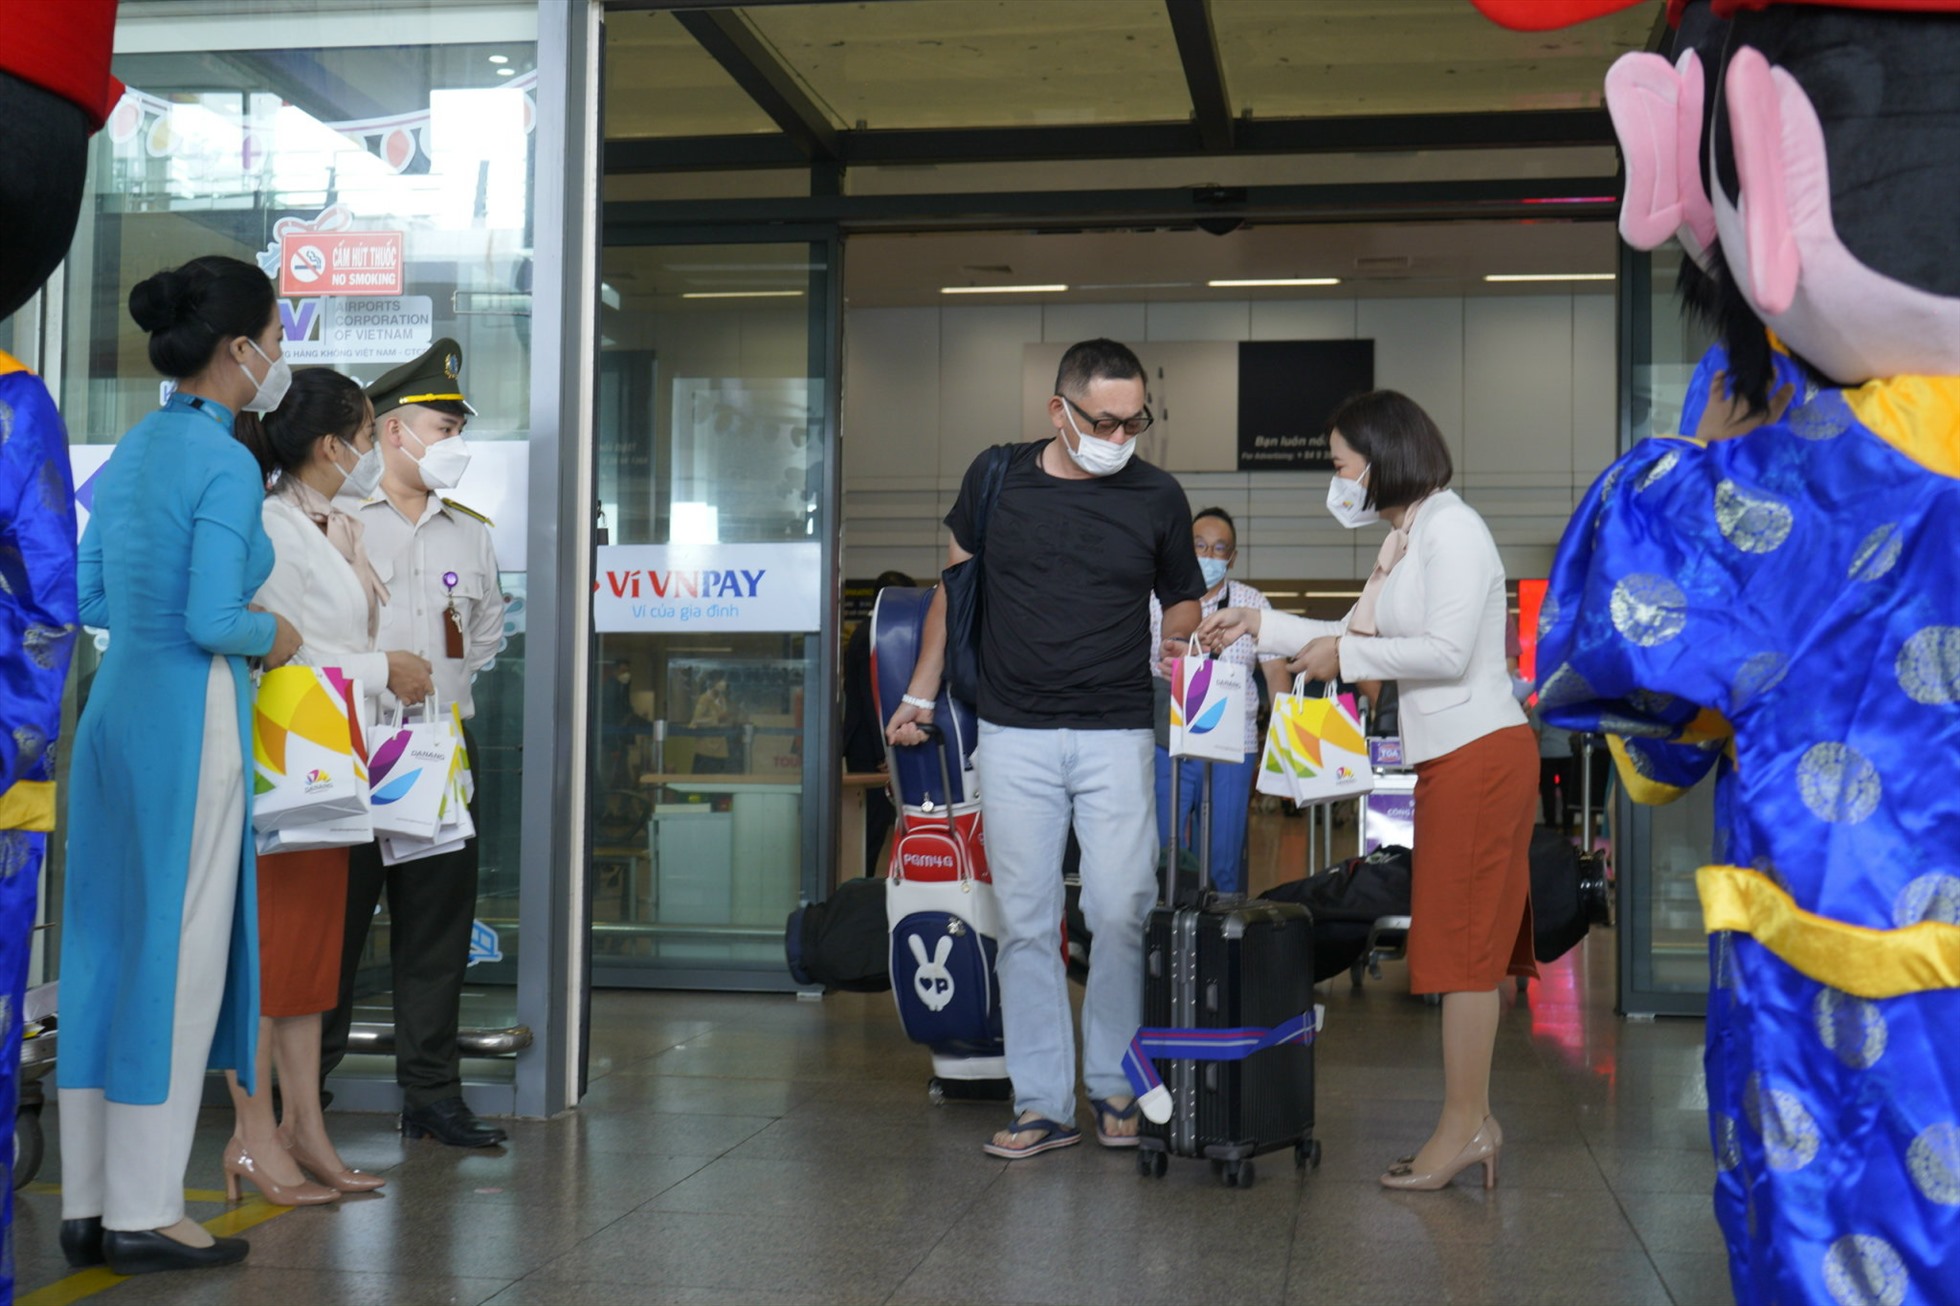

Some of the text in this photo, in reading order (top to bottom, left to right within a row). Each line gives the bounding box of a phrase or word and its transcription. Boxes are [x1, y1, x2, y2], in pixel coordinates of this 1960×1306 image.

[332, 238, 397, 267] CẤM HÚT THUỐC
[331, 272, 397, 286] NO SMOKING
[335, 300, 402, 313] AIRPORTS
[334, 313, 430, 327] CORPORATION
[334, 328, 414, 341] OF VIETNAM
[375, 348, 397, 357] NAM
[404, 347, 427, 357] CTC
[1254, 436, 1278, 448] Bạn
[1280, 435, 1307, 447] luôn
[1241, 451, 1254, 460] For
[606, 569, 767, 599] Ví VNPAY
[650, 603, 676, 618] của
[679, 604, 702, 622] gia
[706, 603, 740, 618] đình
